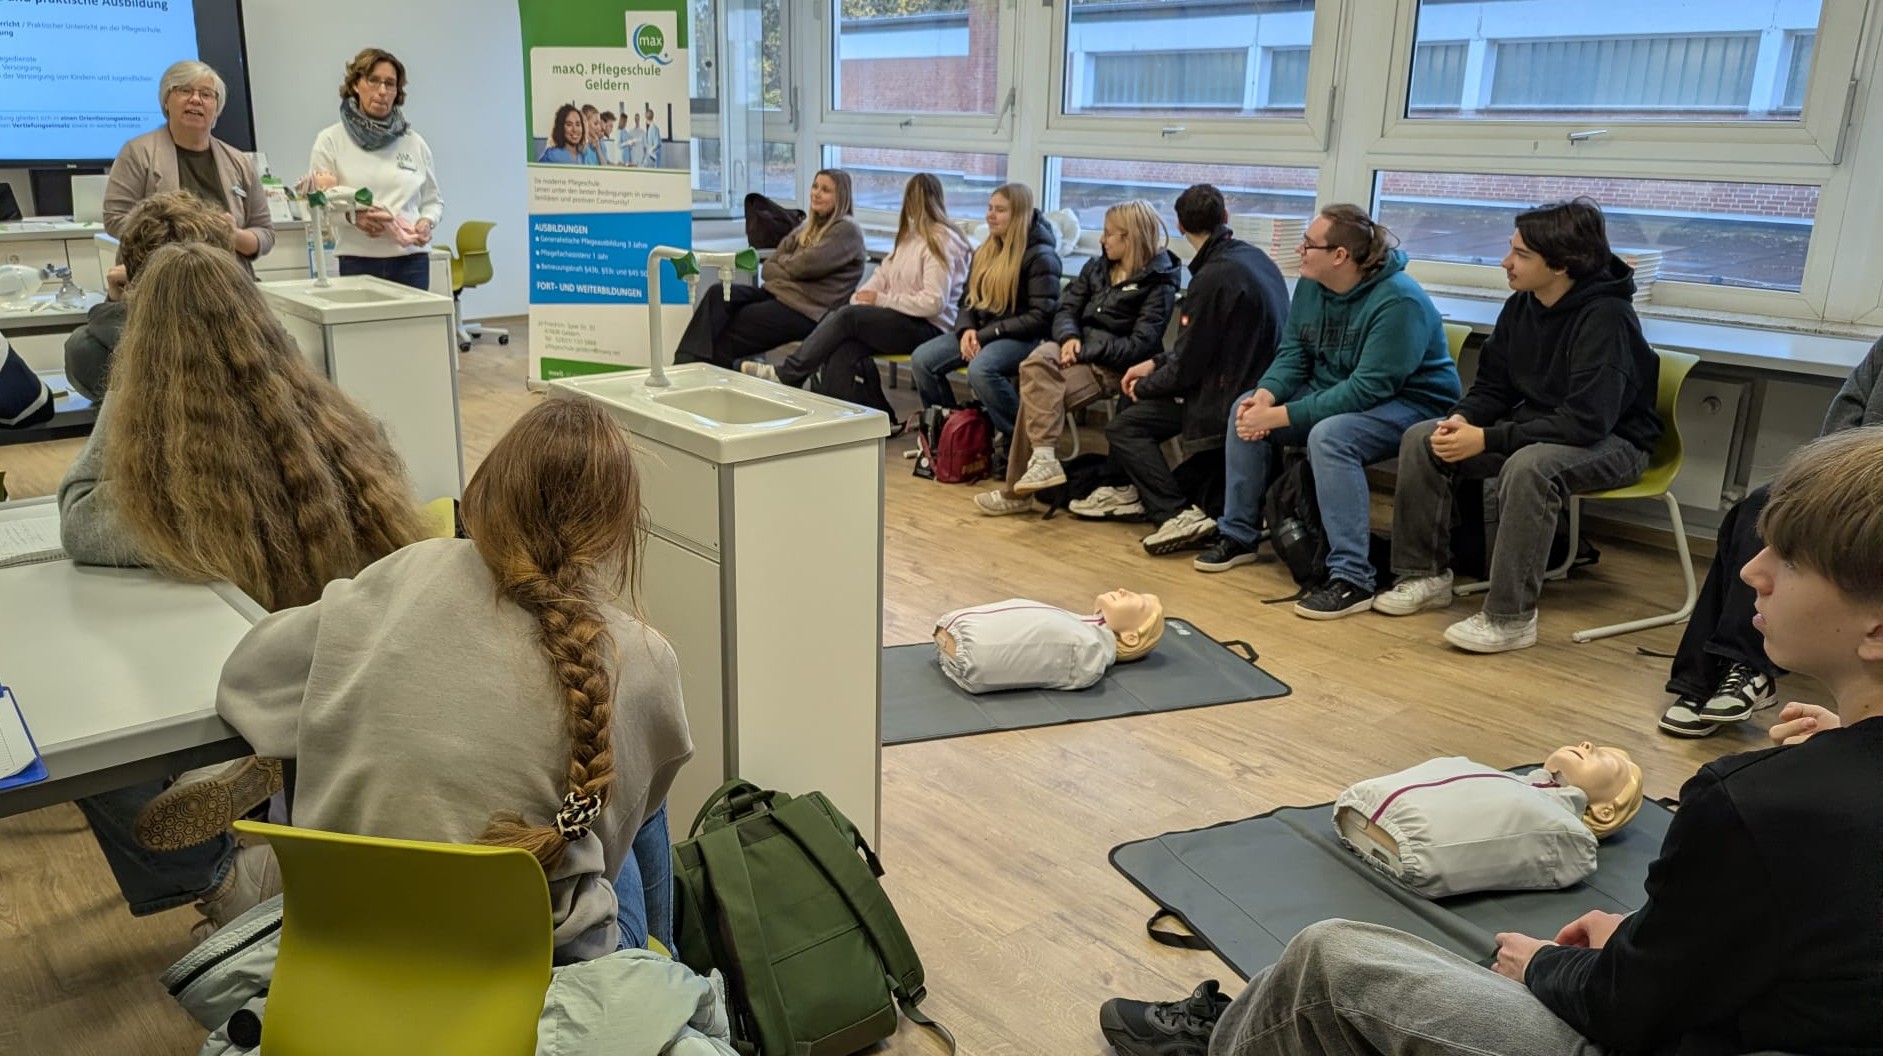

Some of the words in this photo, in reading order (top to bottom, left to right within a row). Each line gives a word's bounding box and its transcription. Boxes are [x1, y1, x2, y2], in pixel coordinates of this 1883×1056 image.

[102, 0, 169, 12] Ausbildung
[638, 35, 663, 47] max
[552, 64, 588, 76] maxQ.
[591, 63, 662, 79] Pflegeschule
[585, 79, 630, 91] Geldern
[534, 223, 588, 235] AUSBILDUNGEN
[536, 281, 559, 291] FORT-
[559, 282, 576, 292] UND
[576, 284, 643, 298] WEITERBILDUNGEN
